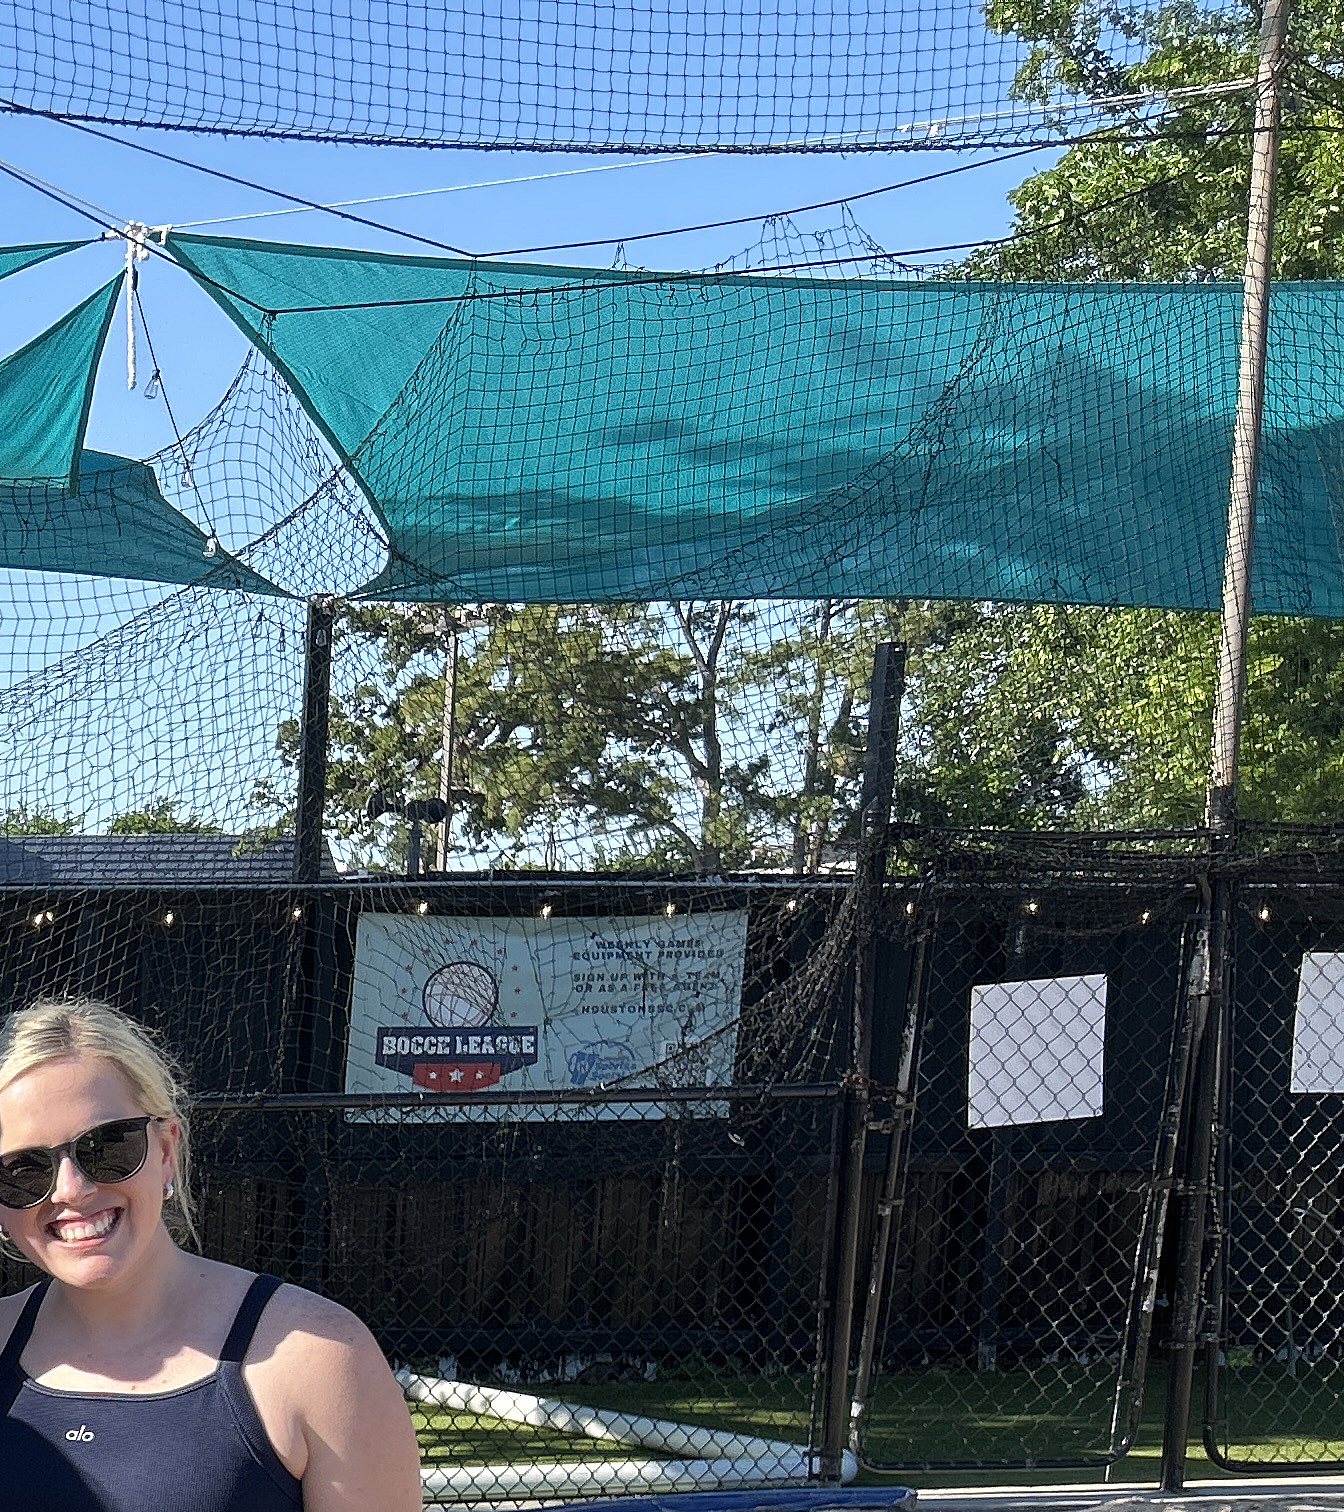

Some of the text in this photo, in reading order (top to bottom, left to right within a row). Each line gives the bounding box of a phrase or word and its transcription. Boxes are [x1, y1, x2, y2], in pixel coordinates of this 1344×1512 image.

[595, 940, 651, 949] WEEKLY
[572, 950, 724, 960] EQUIPMENT PROVIDED
[573, 973, 605, 981] SIGN
[611, 973, 628, 981] UP
[575, 983, 593, 992] OR
[598, 984, 616, 992] AS
[382, 1035, 535, 1056] BOCCE LEAGUE
[65, 1424, 95, 1442] alo
